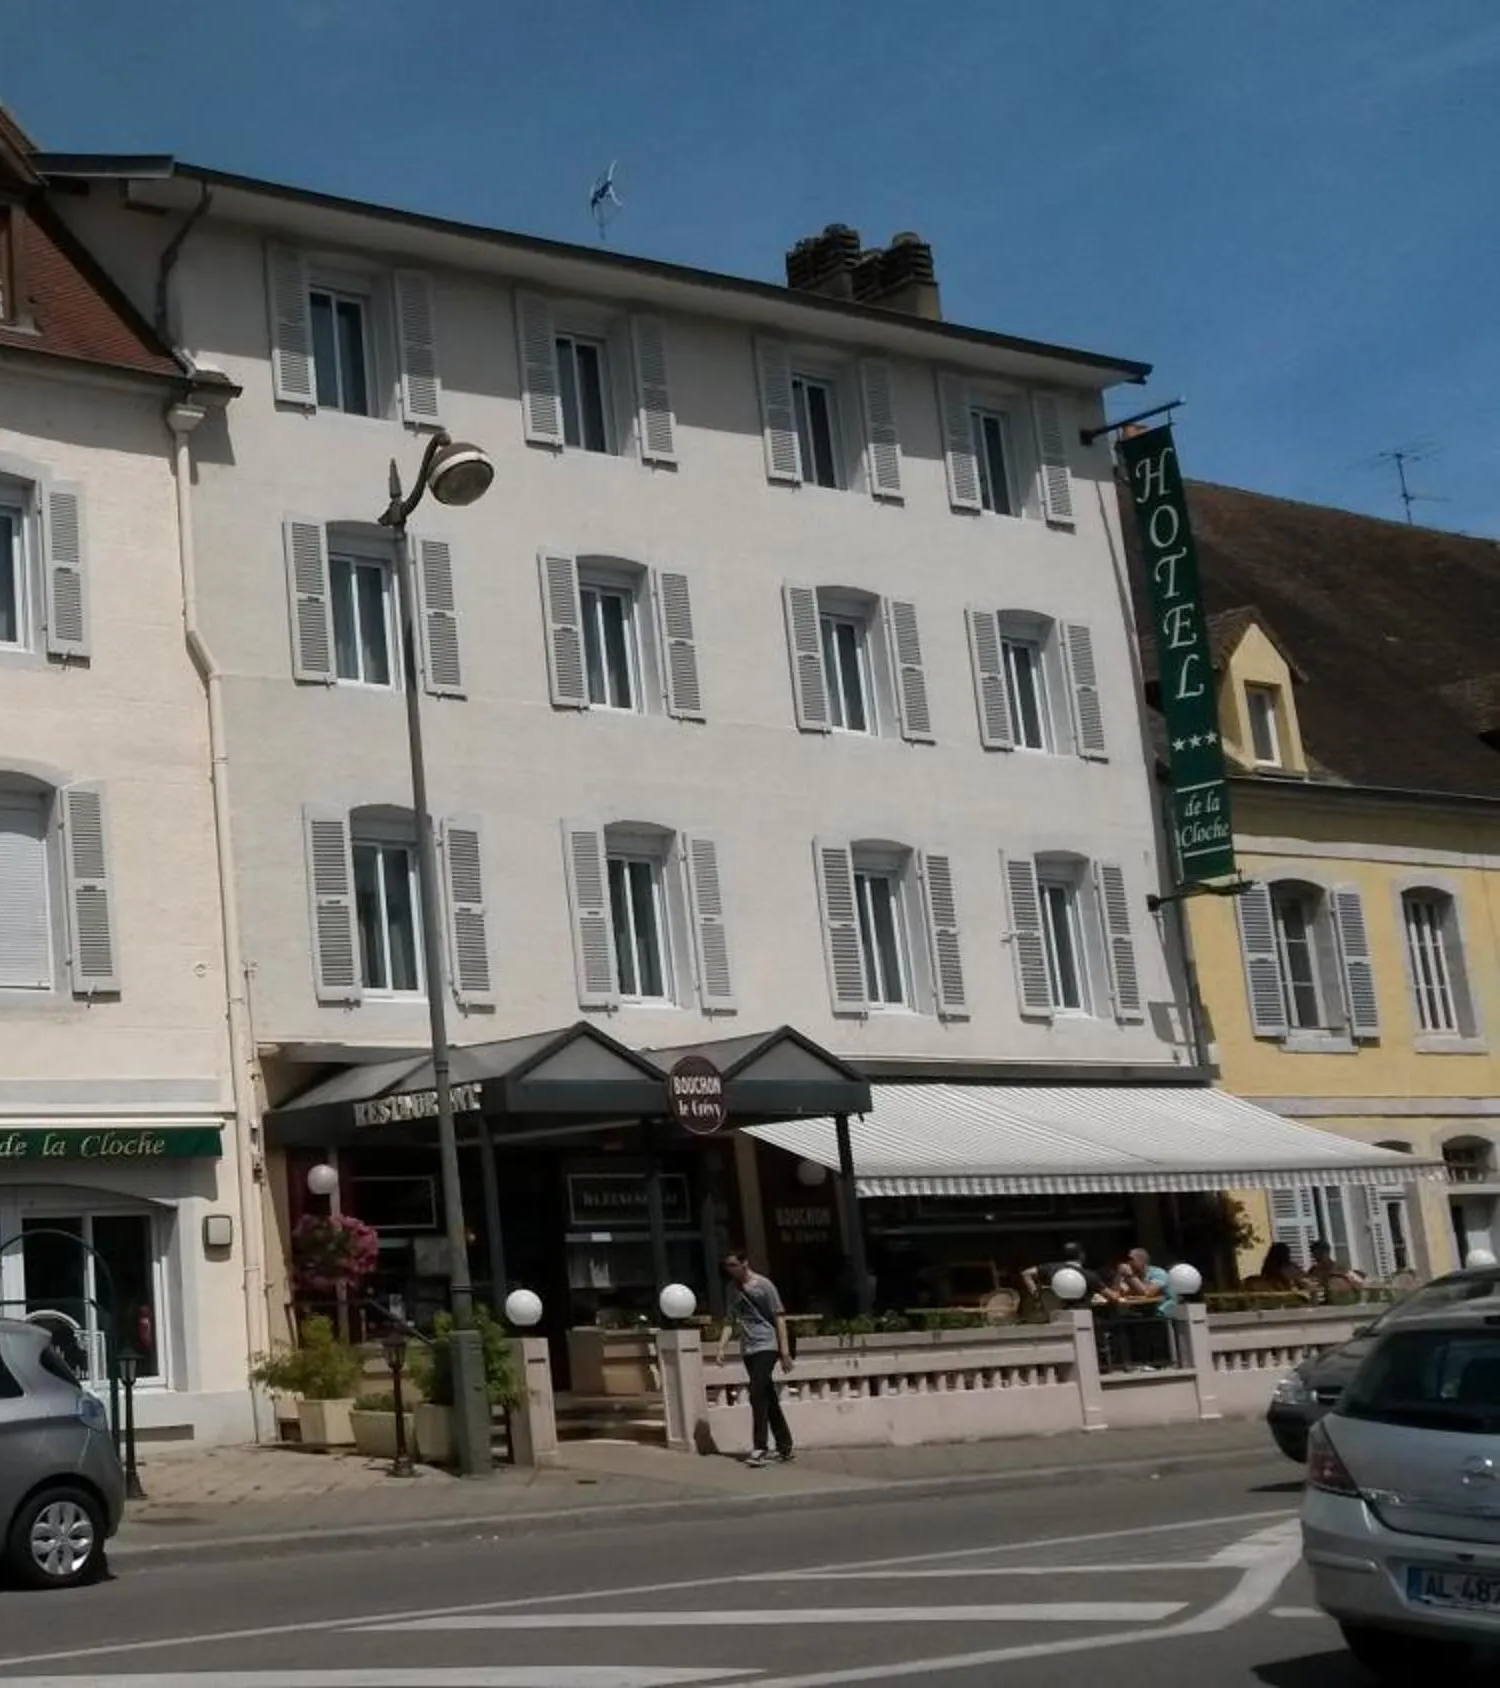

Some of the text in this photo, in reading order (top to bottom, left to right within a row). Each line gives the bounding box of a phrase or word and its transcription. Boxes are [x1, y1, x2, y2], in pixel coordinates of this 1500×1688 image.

[1135, 447, 1205, 701] HOTEL
[1184, 789, 1221, 817] de la
[1181, 816, 1230, 848] Cloche
[673, 1075, 722, 1095] BOUCHON
[353, 1083, 483, 1127] RESTAURNT
[42, 1132, 66, 1156] la
[81, 1131, 165, 1158] Cloche
